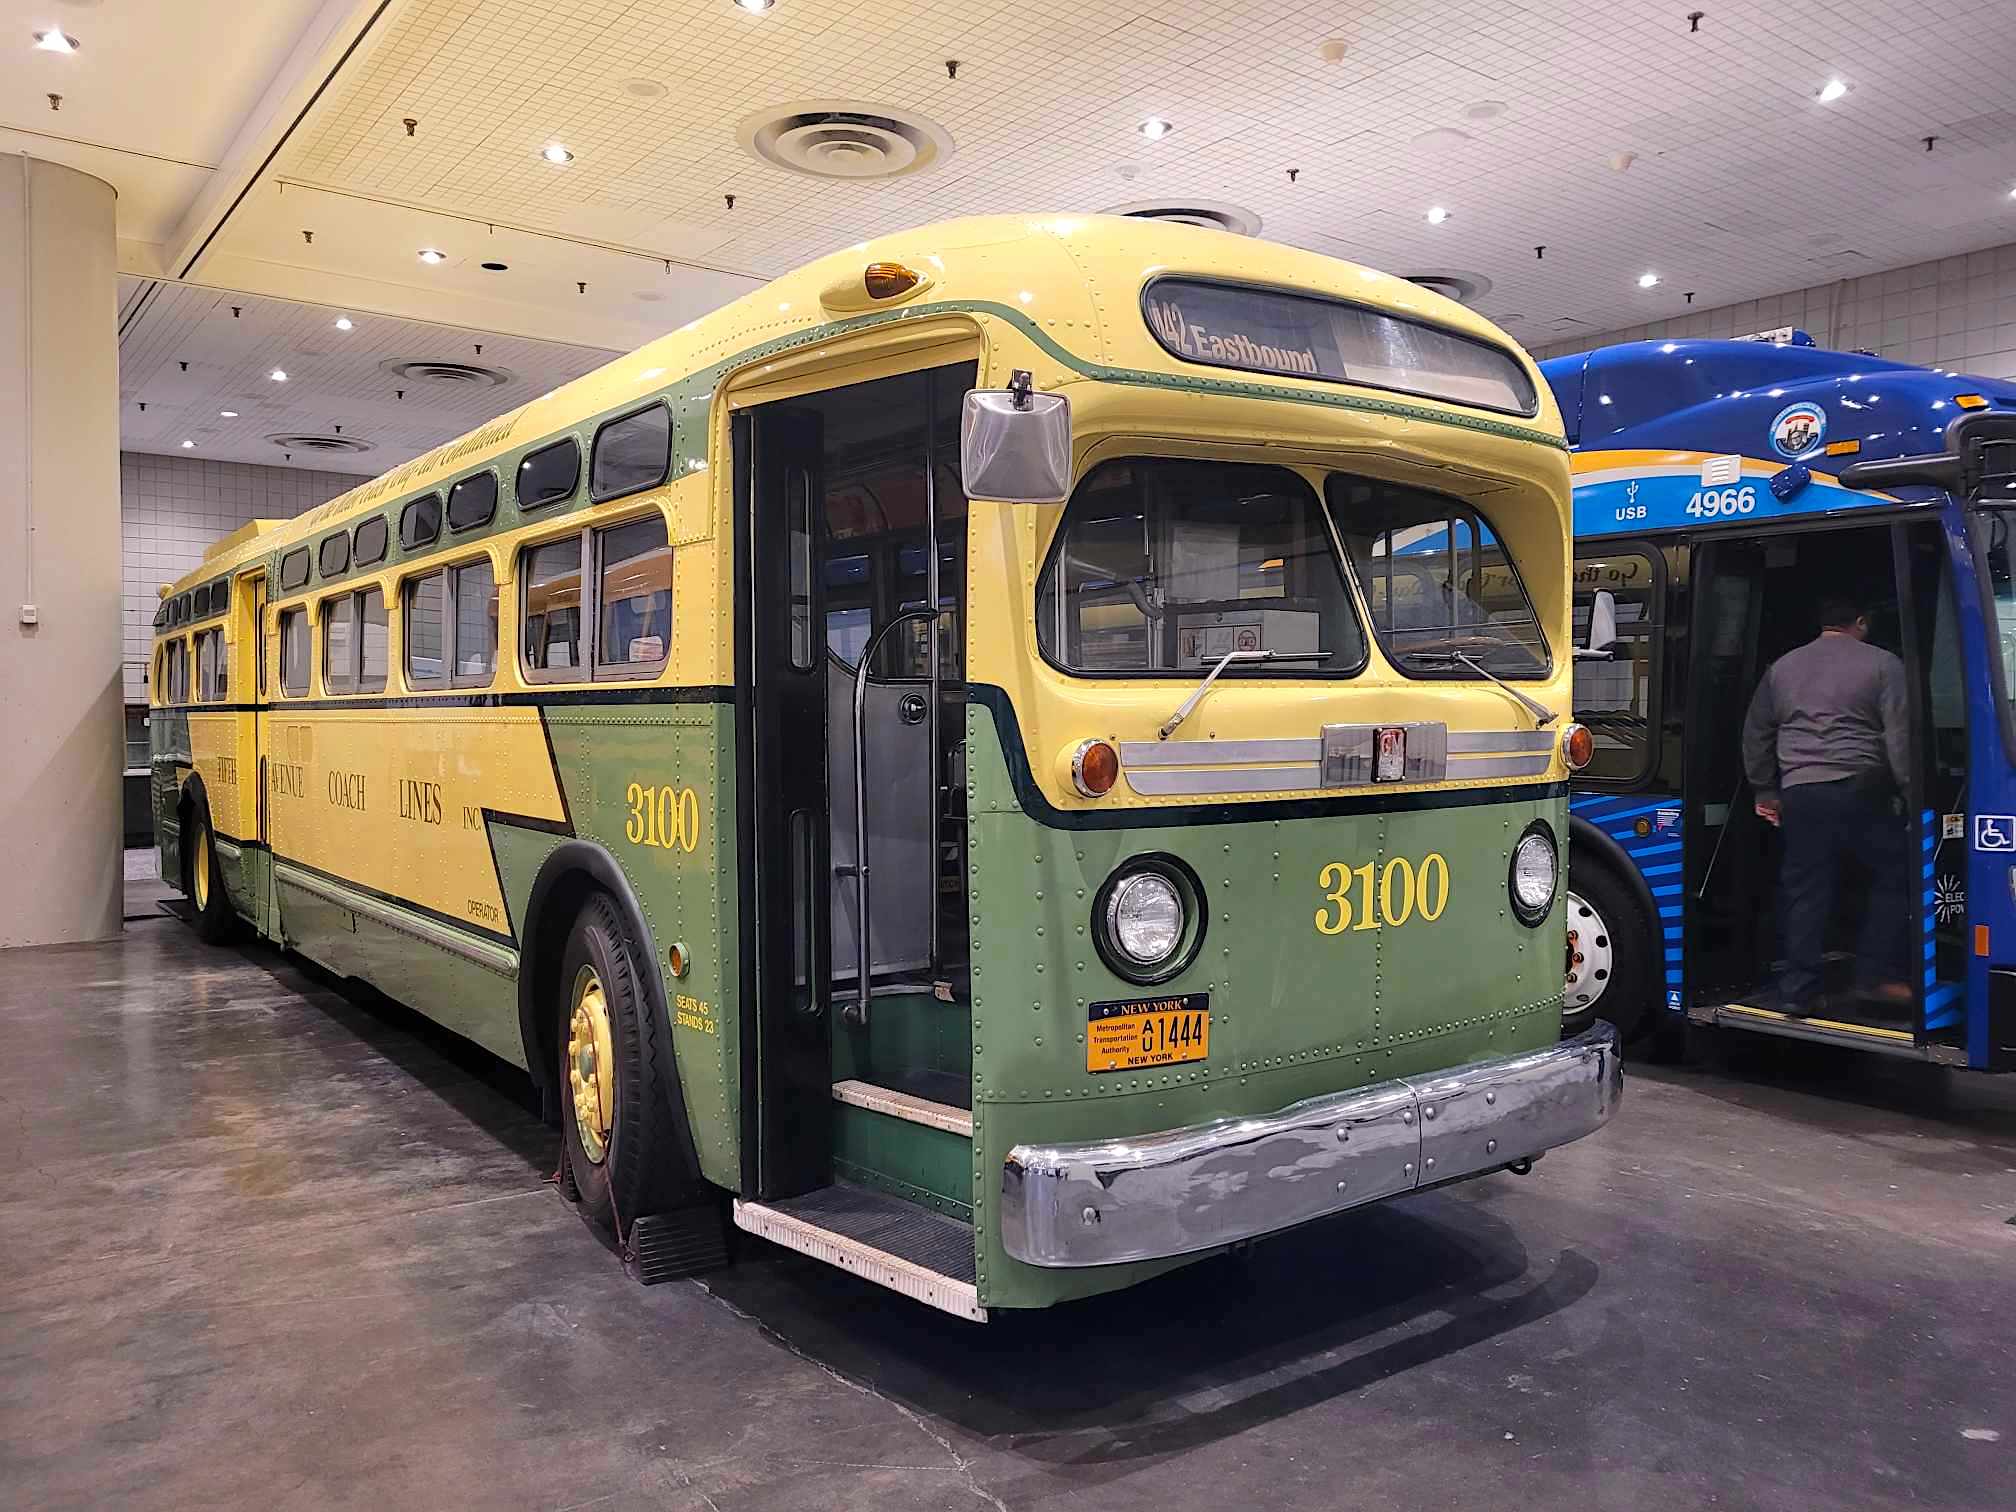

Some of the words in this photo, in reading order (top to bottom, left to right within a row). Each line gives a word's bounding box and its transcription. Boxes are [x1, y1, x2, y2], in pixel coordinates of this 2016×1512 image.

[1189, 325, 1318, 374] Eastbound
[1615, 505, 1647, 520] USB
[1685, 486, 1756, 518] 4966
[271, 762, 304, 798] AVENUE
[328, 770, 366, 811] COACH
[399, 779, 442, 825] LINES
[626, 783, 699, 853] 3100
[1315, 852, 1449, 935] 3100
[467, 899, 499, 923] OPERATOR
[676, 994, 698, 1012] SEATS
[699, 1001, 709, 1015] 45
[1121, 1003, 1151, 1015] NEW
[1153, 999, 1182, 1013] YORK
[677, 1011, 704, 1030] STANDS
[704, 1019, 714, 1034] 23
[1096, 1023, 1136, 1032] Metropolitan
[1094, 1034, 1138, 1043] Transportation
[1101, 1046, 1130, 1055] Authority
[1127, 1056, 1148, 1065] NEW
[1150, 1053, 1174, 1063] YORK
